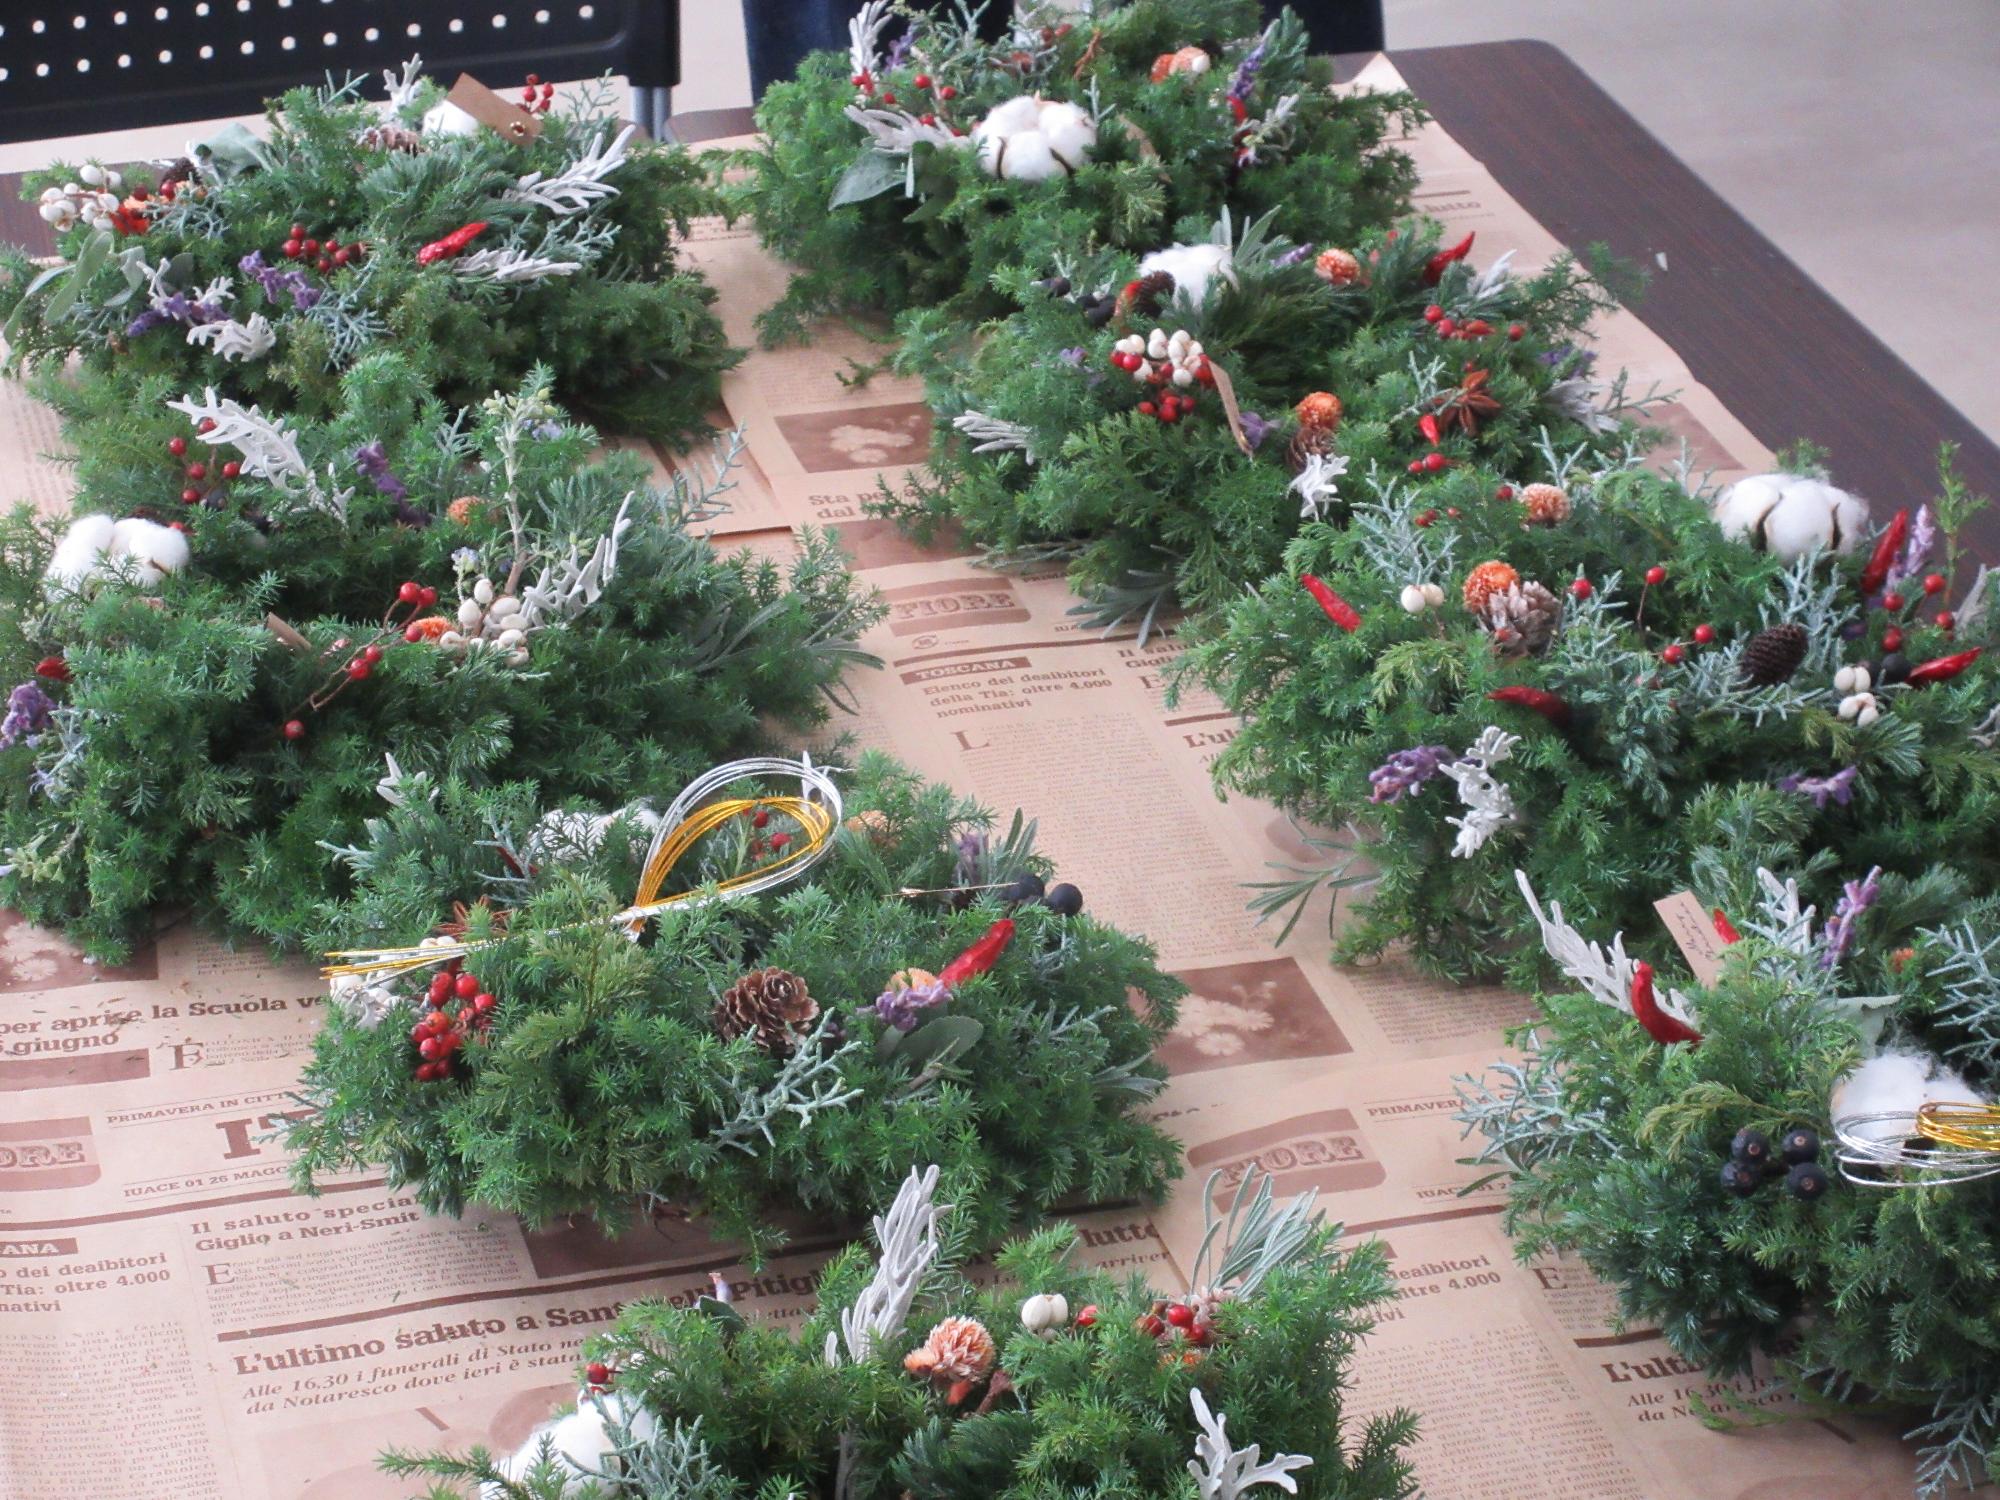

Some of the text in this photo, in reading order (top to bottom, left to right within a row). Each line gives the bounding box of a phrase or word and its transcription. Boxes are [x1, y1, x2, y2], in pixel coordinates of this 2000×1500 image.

[809, 494, 849, 506] Sta
[817, 506, 856, 518] dal
[895, 593, 1016, 620] FIORE
[916, 659, 1016, 681] TOSCANA
[1125, 656, 1173, 669] Gigli
[923, 678, 981, 696] Elenco
[988, 674, 1016, 691] dei
[930, 678, 1113, 708] della Tia: oltre 4.000
[936, 699, 1033, 719] nominativi
[953, 729, 991, 751] L
[51, 1009, 142, 1033] aprire
[152, 1004, 179, 1020] la
[189, 997, 288, 1017] Scuola
[13, 1030, 119, 1057] giugno
[106, 1103, 215, 1125] PRIMAVERA
[220, 1098, 240, 1110] IN
[185, 1178, 205, 1190] 01
[209, 1175, 230, 1186] 26
[190, 1198, 418, 1236] Il saluto specia
[195, 1211, 421, 1253] Giglio a Neri-Smit
[16, 1265, 51, 1279] dei
[54, 1278, 108, 1295] oltre
[116, 1269, 171, 1287] 4.000
[201, 1261, 236, 1288] E
[1448, 1271, 1502, 1291] 4.000
[1531, 1267, 1567, 1291] E
[233, 1336, 387, 1376] L'ultimo
[395, 1316, 507, 1350] saluto
[515, 1315, 541, 1331] a
[242, 1385, 283, 1400] Alle
[356, 1369, 364, 1382] i
[368, 1354, 460, 1386] funerali
[467, 1347, 491, 1363] di
[496, 1339, 552, 1358] Stato
[246, 1400, 276, 1417] da
[283, 1382, 398, 1410] Notaresco
[404, 1371, 457, 1390] dove
[463, 1362, 501, 1381] ieri
[508, 1358, 520, 1372] è
[1627, 1392, 1665, 1408] Alle
[1638, 1406, 1665, 1423] da
